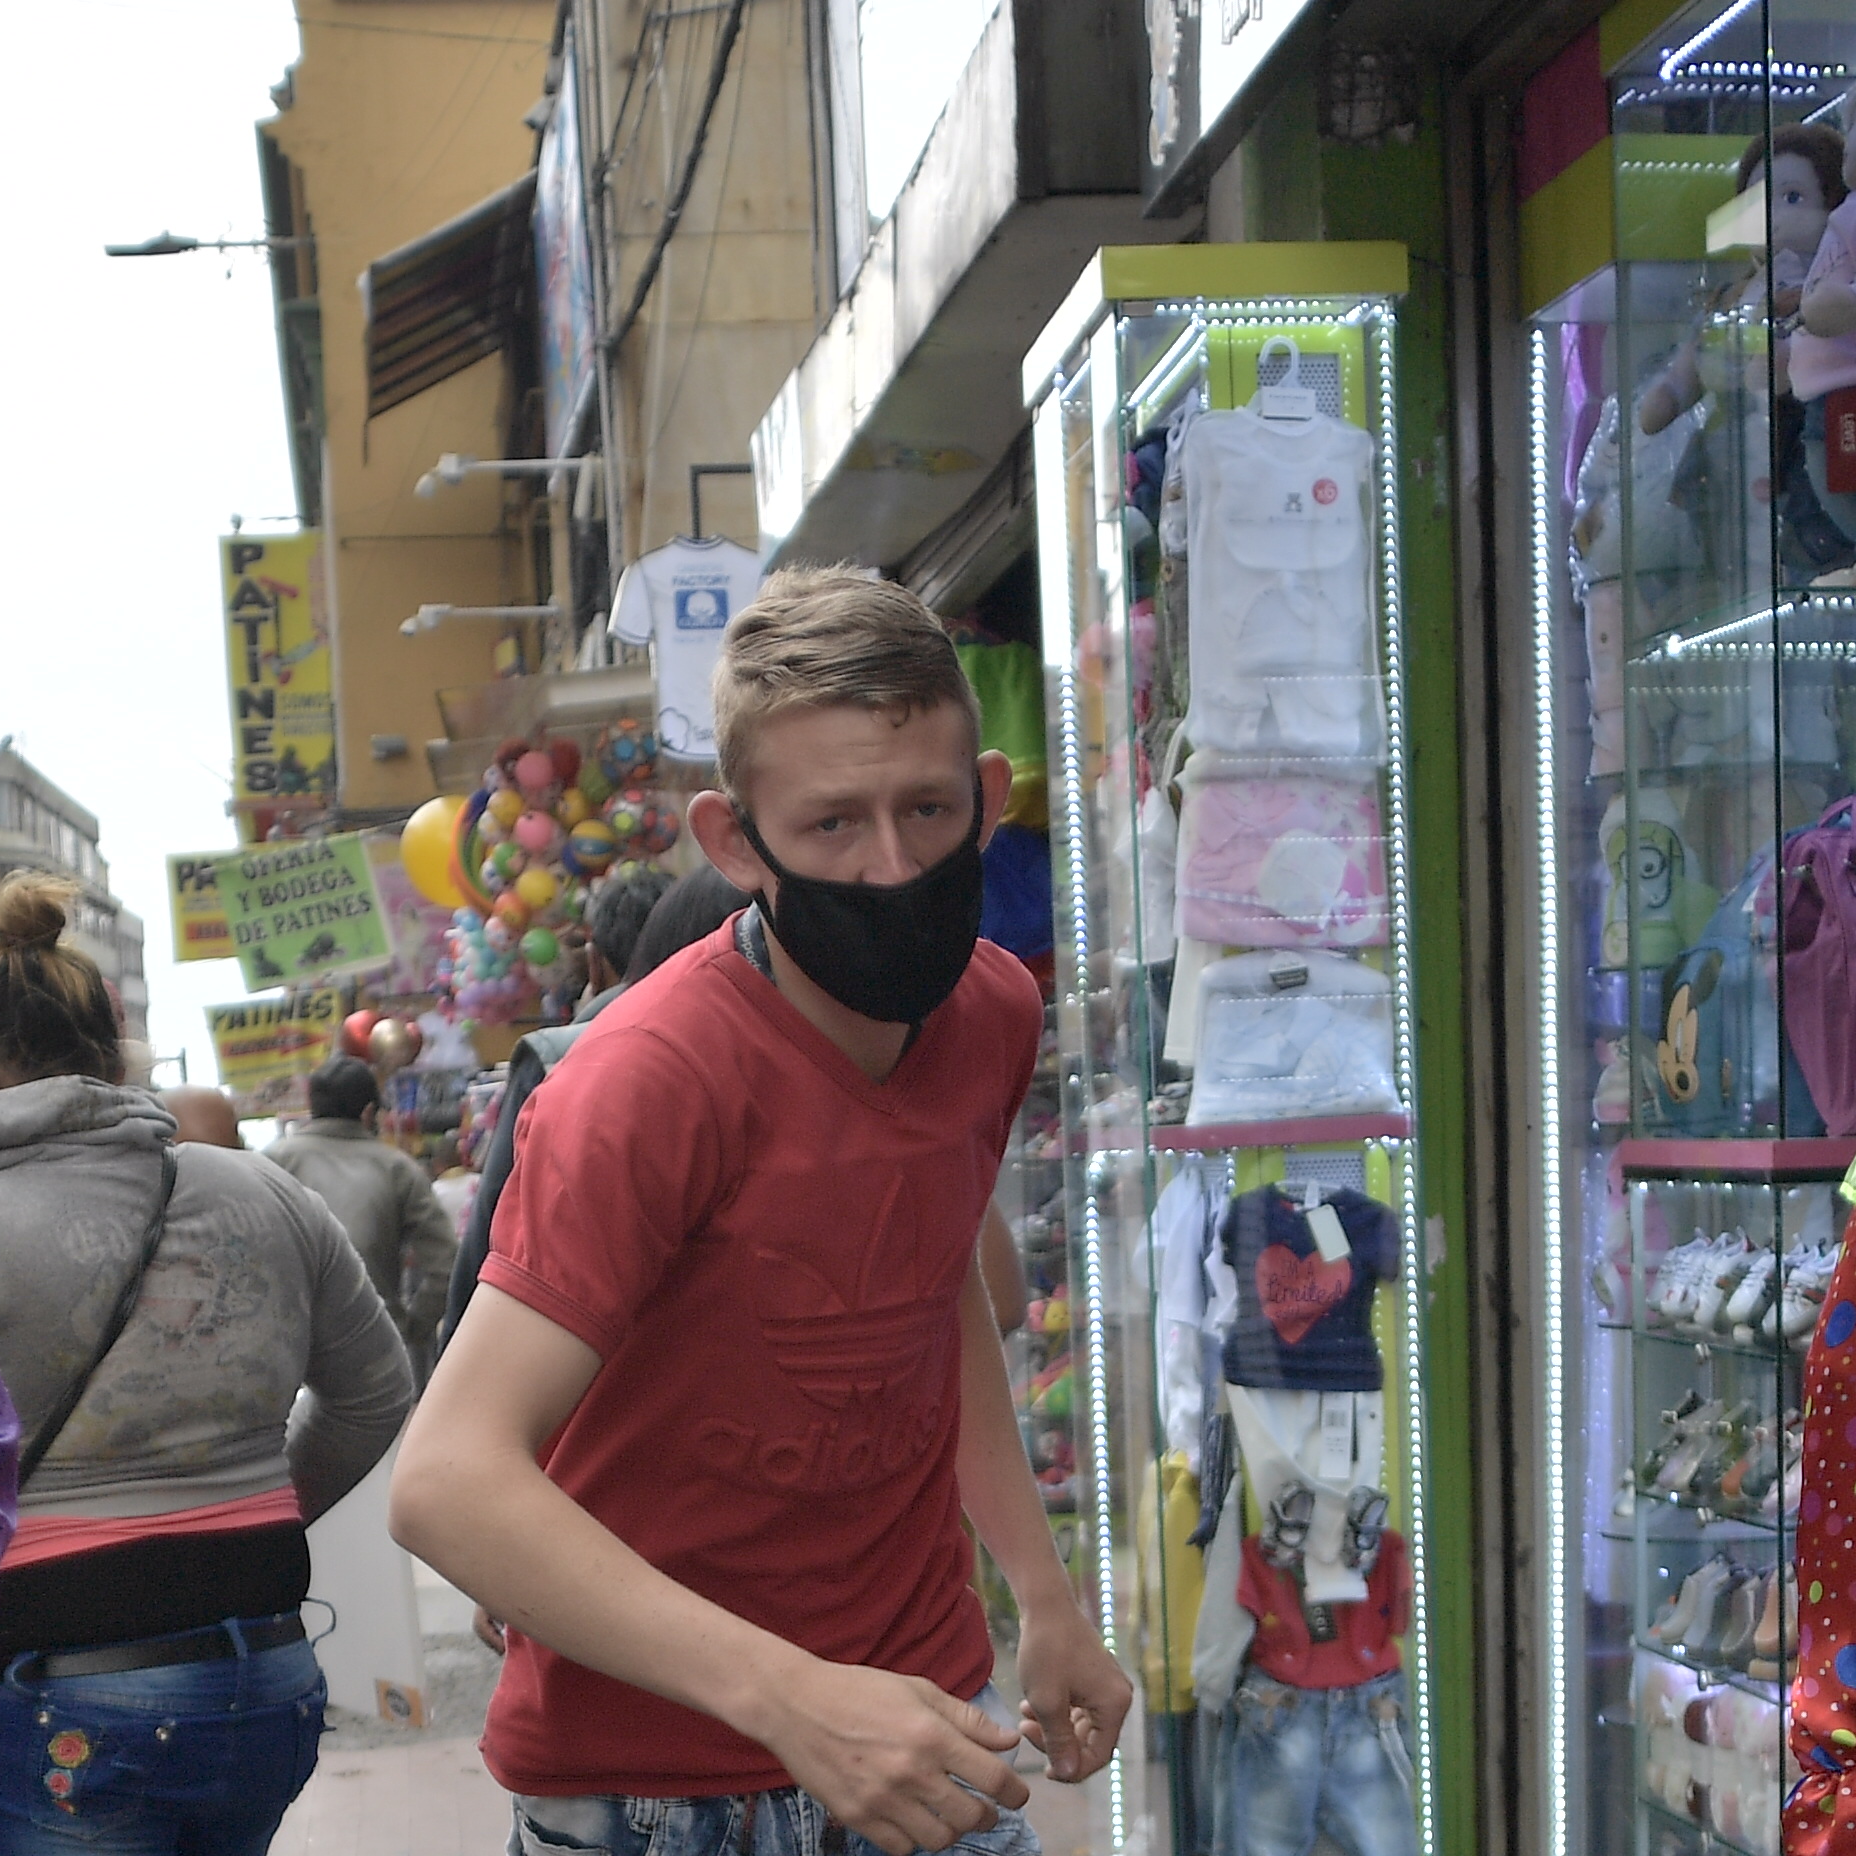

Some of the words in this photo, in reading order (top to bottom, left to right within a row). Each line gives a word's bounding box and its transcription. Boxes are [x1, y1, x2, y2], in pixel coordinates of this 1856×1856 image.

[230, 542, 279, 792] PATINES
[242, 841, 335, 880] OFERTA
[237, 890, 251, 912] Y
[258, 866, 356, 907] BODEGA
[235, 922, 268, 945] DE
[273, 891, 371, 936] PATINES
